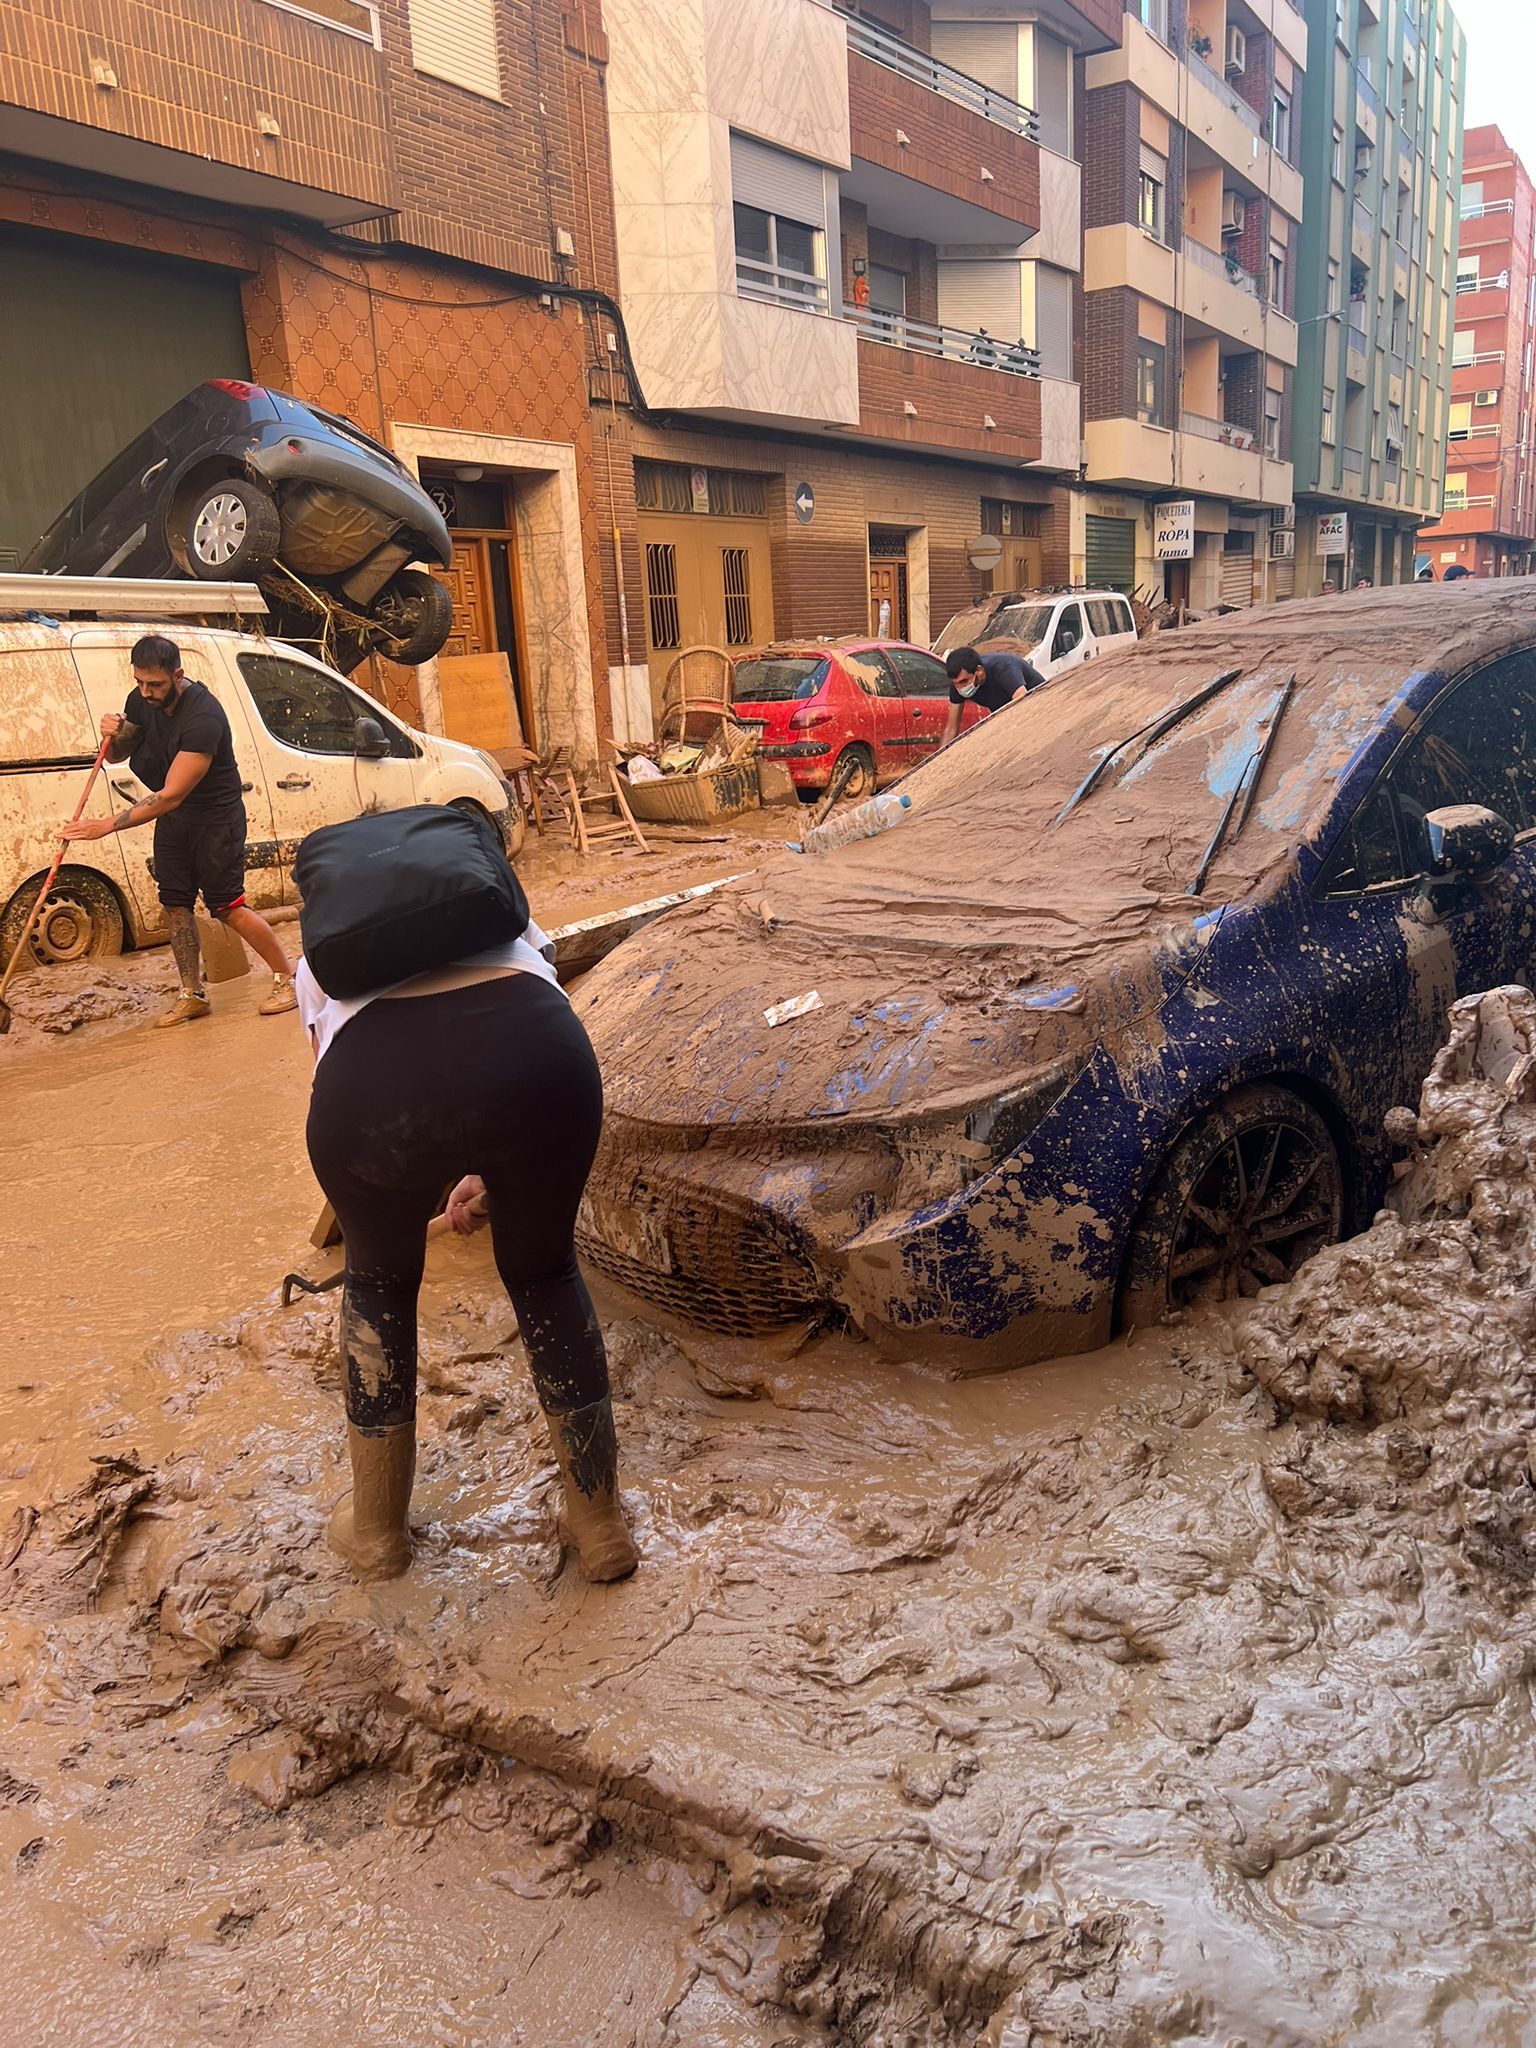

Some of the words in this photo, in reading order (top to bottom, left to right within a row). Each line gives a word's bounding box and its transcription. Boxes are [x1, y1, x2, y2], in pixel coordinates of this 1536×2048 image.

[433, 492, 447, 514] 3
[1157, 529, 1189, 542] ROPA
[1319, 525, 1343, 535] AFAC
[1158, 548, 1188, 558] Inma
